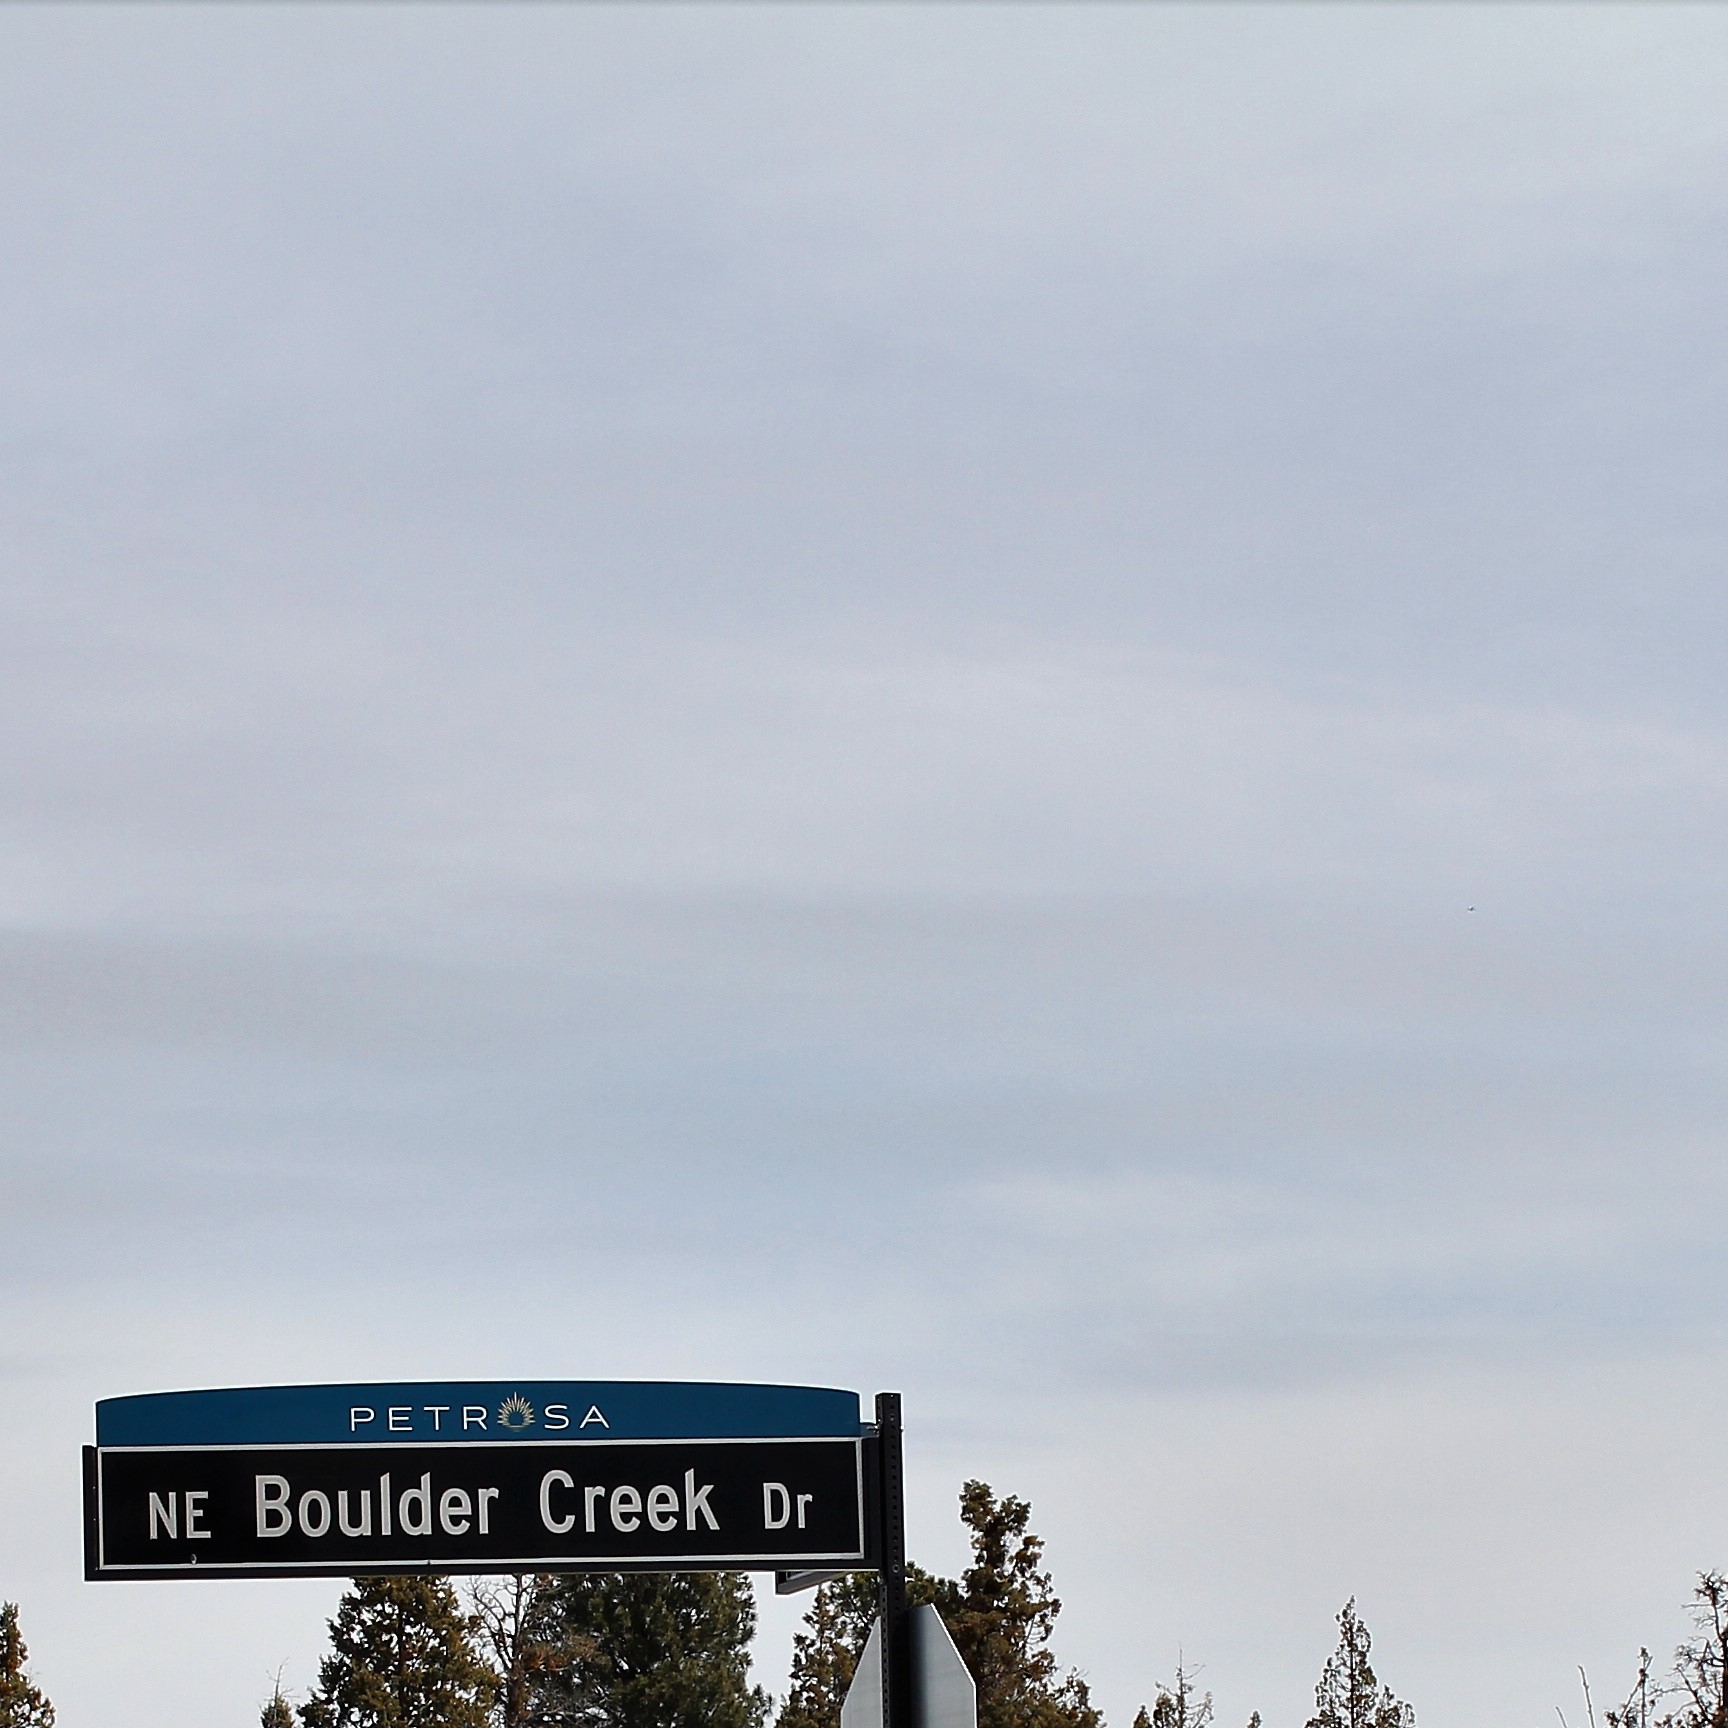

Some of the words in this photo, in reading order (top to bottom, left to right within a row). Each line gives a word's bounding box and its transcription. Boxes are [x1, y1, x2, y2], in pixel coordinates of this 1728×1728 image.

[148, 1490, 212, 1540] NE
[254, 1472, 500, 1539] Boulder
[538, 1466, 721, 1533] Creek
[762, 1481, 814, 1530] Dr
